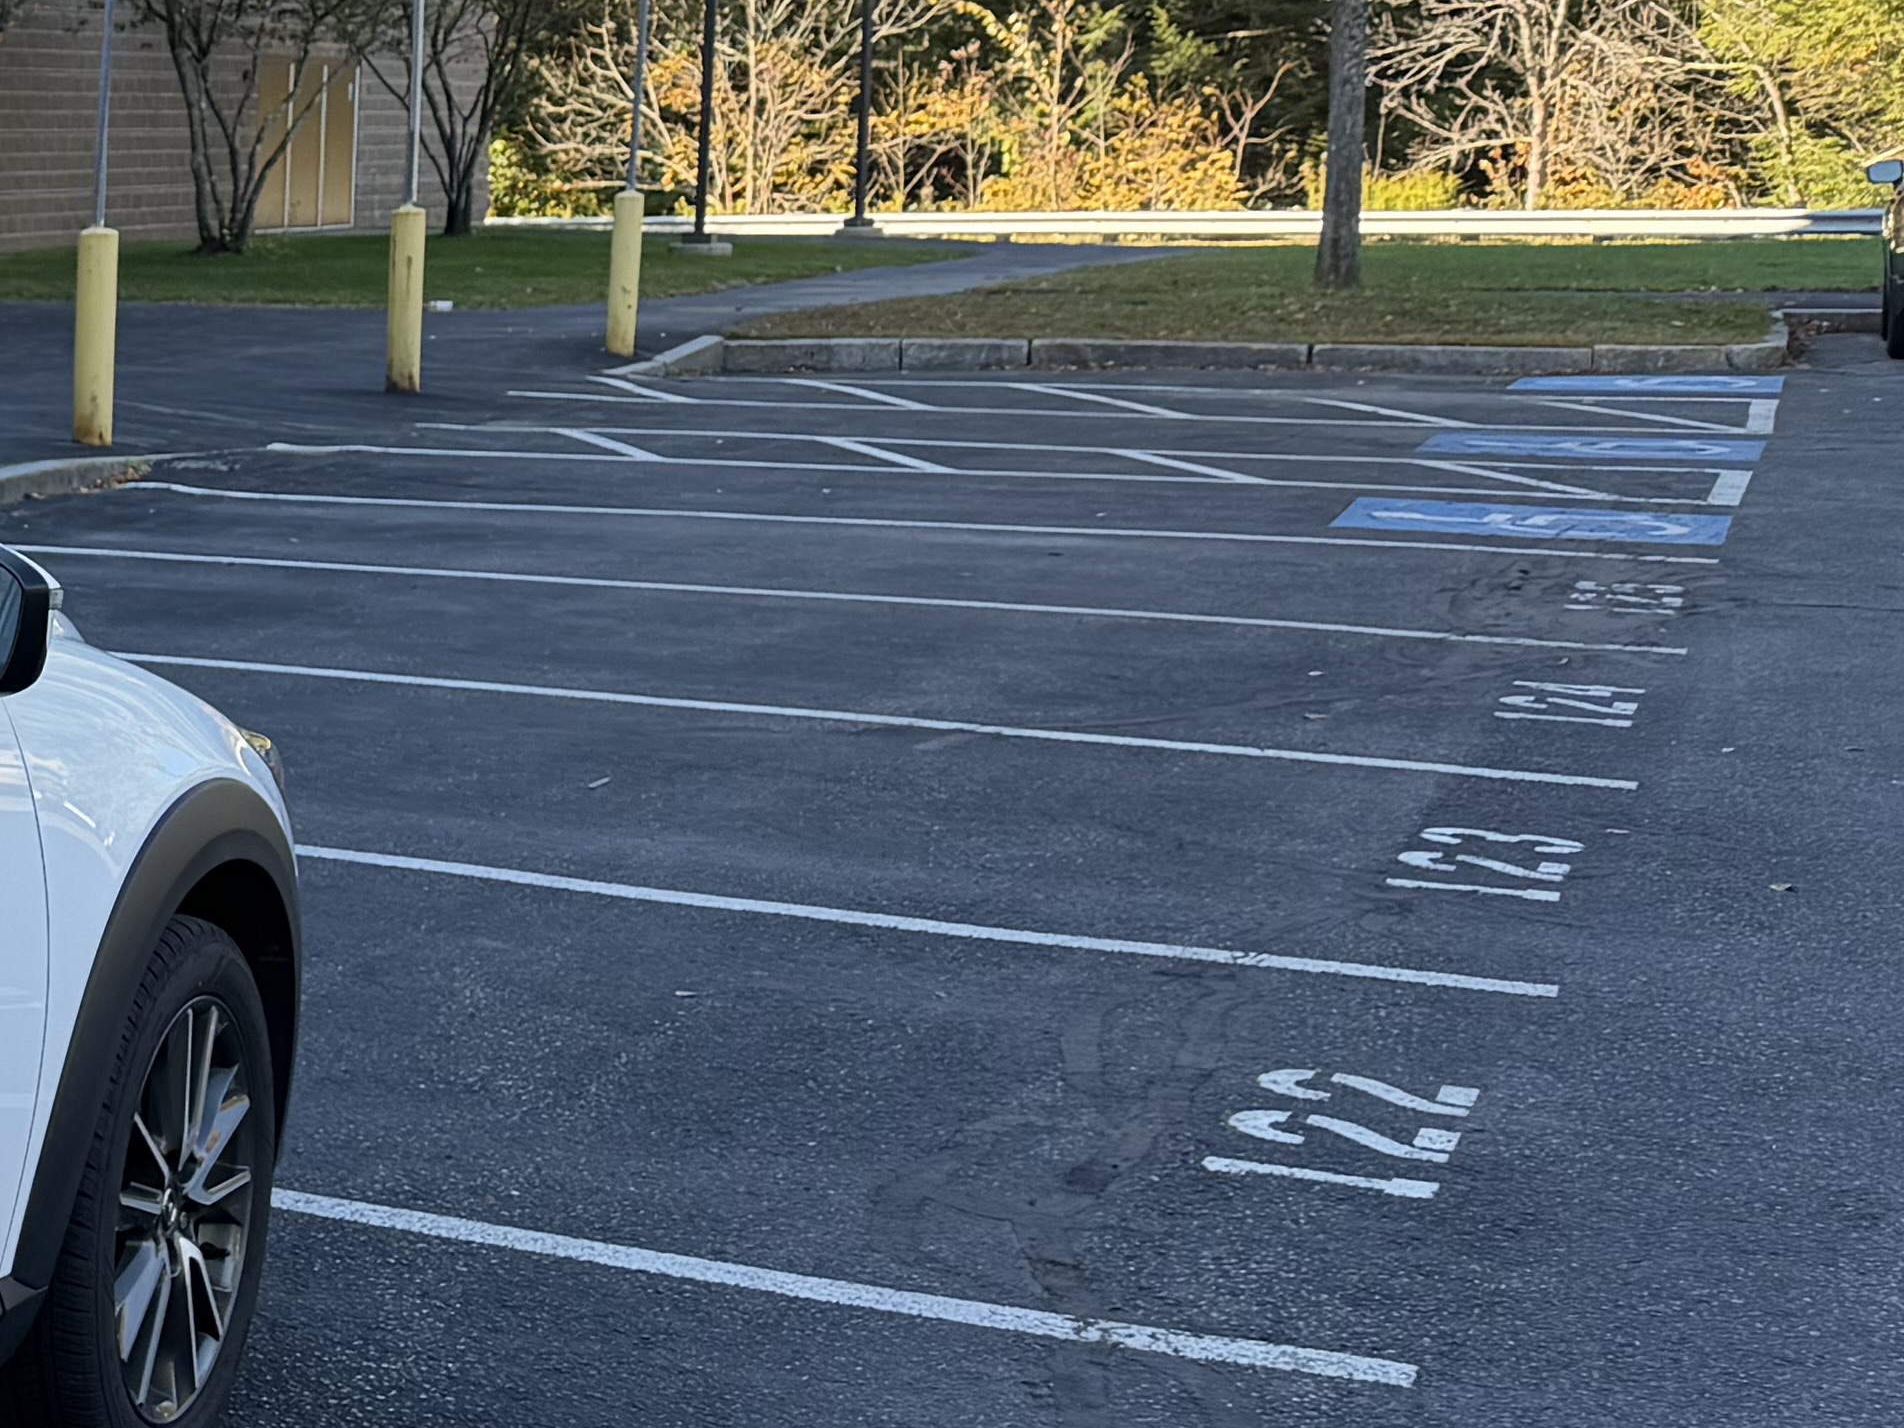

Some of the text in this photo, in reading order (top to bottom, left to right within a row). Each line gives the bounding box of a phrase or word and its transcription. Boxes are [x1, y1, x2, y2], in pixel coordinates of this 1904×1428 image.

[1493, 679, 1647, 728] 124
[1385, 826, 1587, 903] 123
[1200, 1068, 1482, 1200] 122
